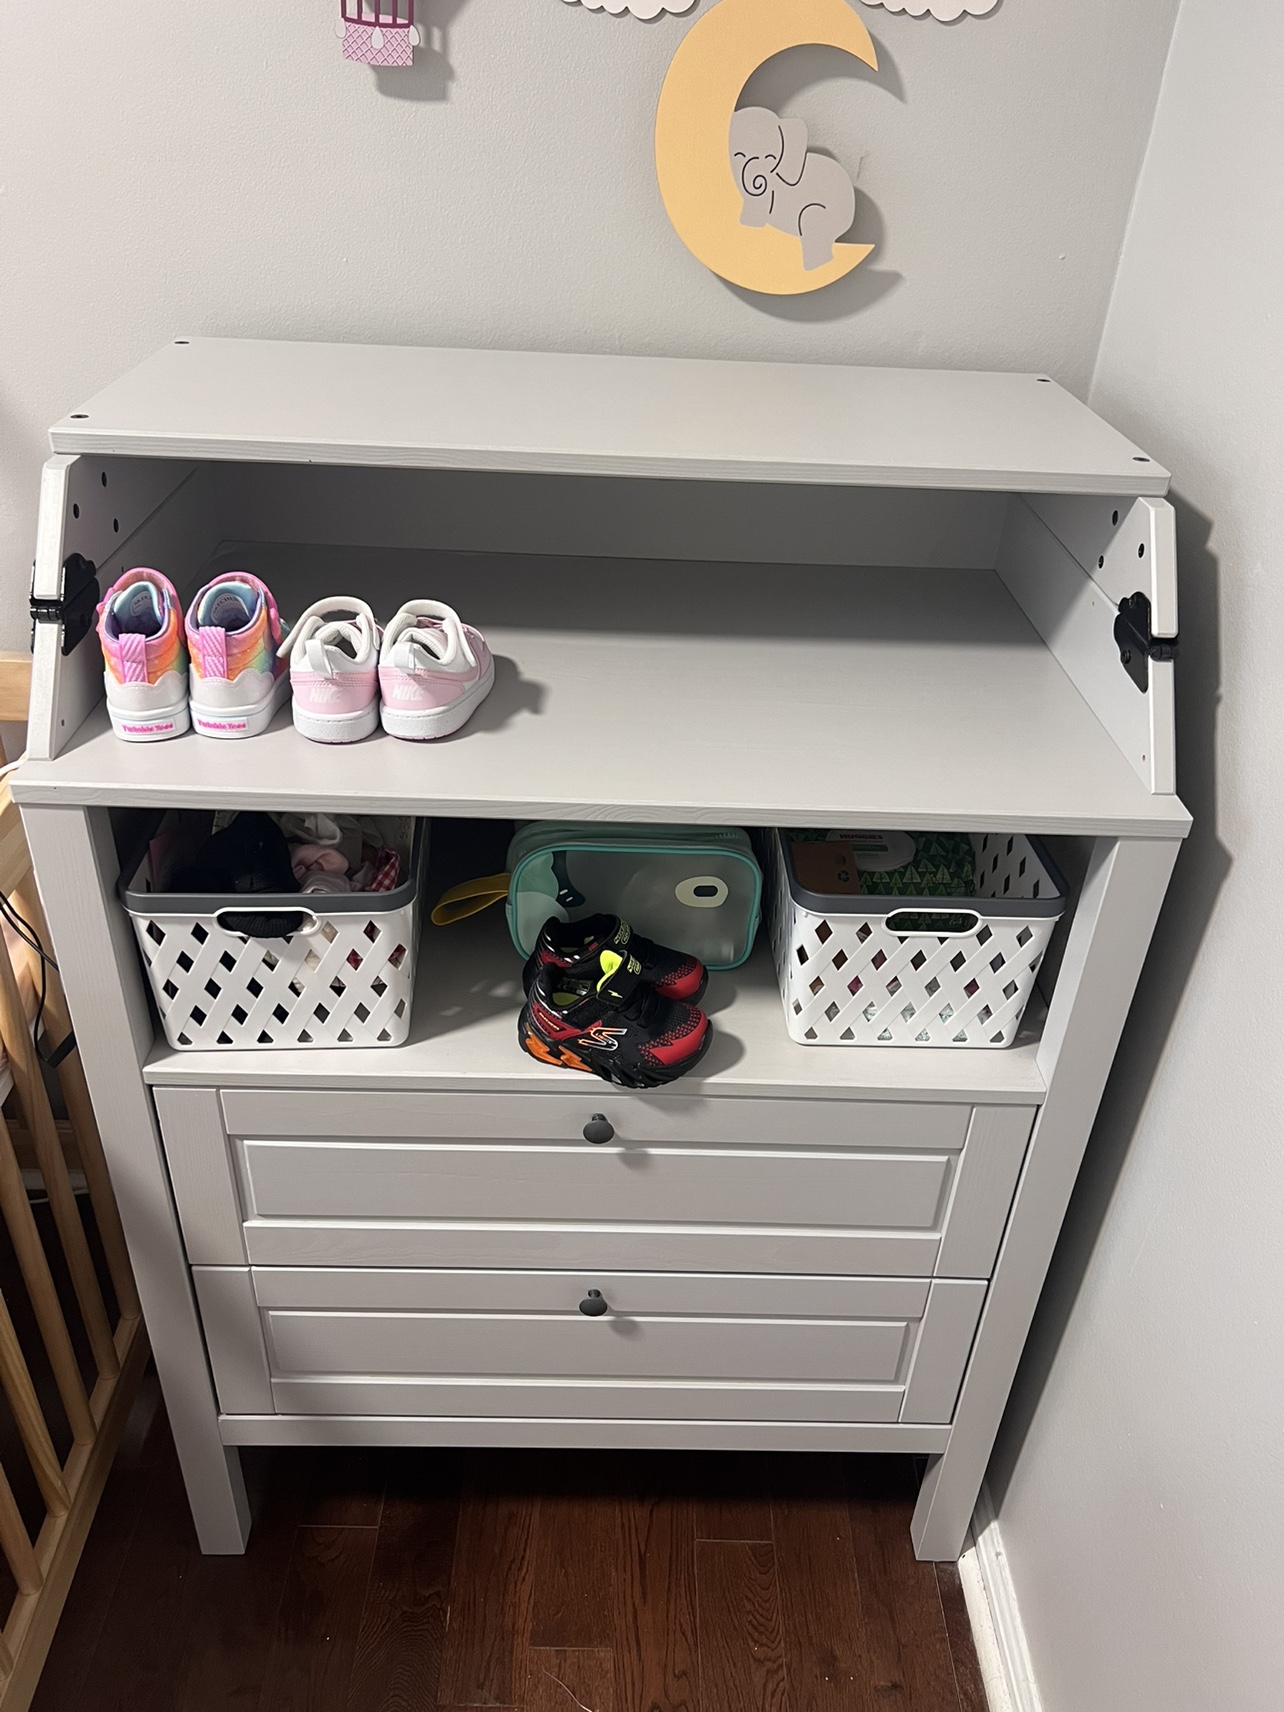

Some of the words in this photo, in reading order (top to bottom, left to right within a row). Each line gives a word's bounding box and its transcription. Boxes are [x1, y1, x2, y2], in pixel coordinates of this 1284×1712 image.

[309, 687, 342, 703] NIKE
[392, 684, 424, 701] NIKE
[123, 725, 154, 734] Twinkle
[197, 719, 226, 730] Twinkle
